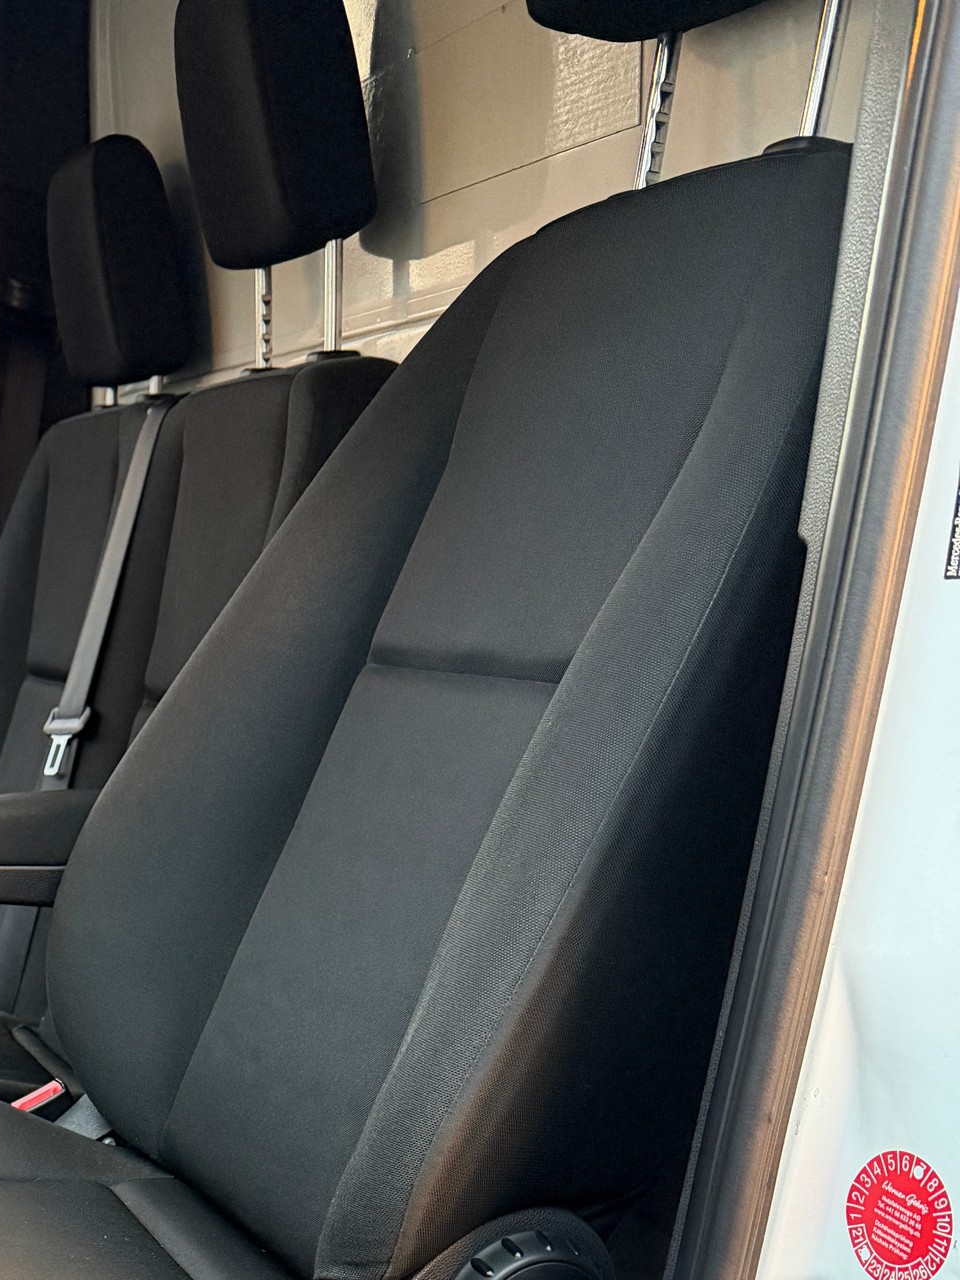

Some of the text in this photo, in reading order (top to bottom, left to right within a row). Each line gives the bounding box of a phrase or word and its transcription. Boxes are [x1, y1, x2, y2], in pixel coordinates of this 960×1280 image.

[873, 1160, 882, 1176] 4
[887, 1154, 895, 1171] 5
[902, 1155, 910, 1172] 6
[860, 1173, 872, 1188] 3
[926, 1178, 939, 1192] 8
[852, 1191, 865, 1204] 2
[934, 1197, 948, 1209] 9
[912, 1213, 921, 1221] AG
[936, 1215, 951, 1233] 10
[852, 1228, 864, 1243] 21
[933, 1238, 948, 1253] 11
[868, 1260, 882, 1277] 23
[923, 1252, 941, 1271] 12
